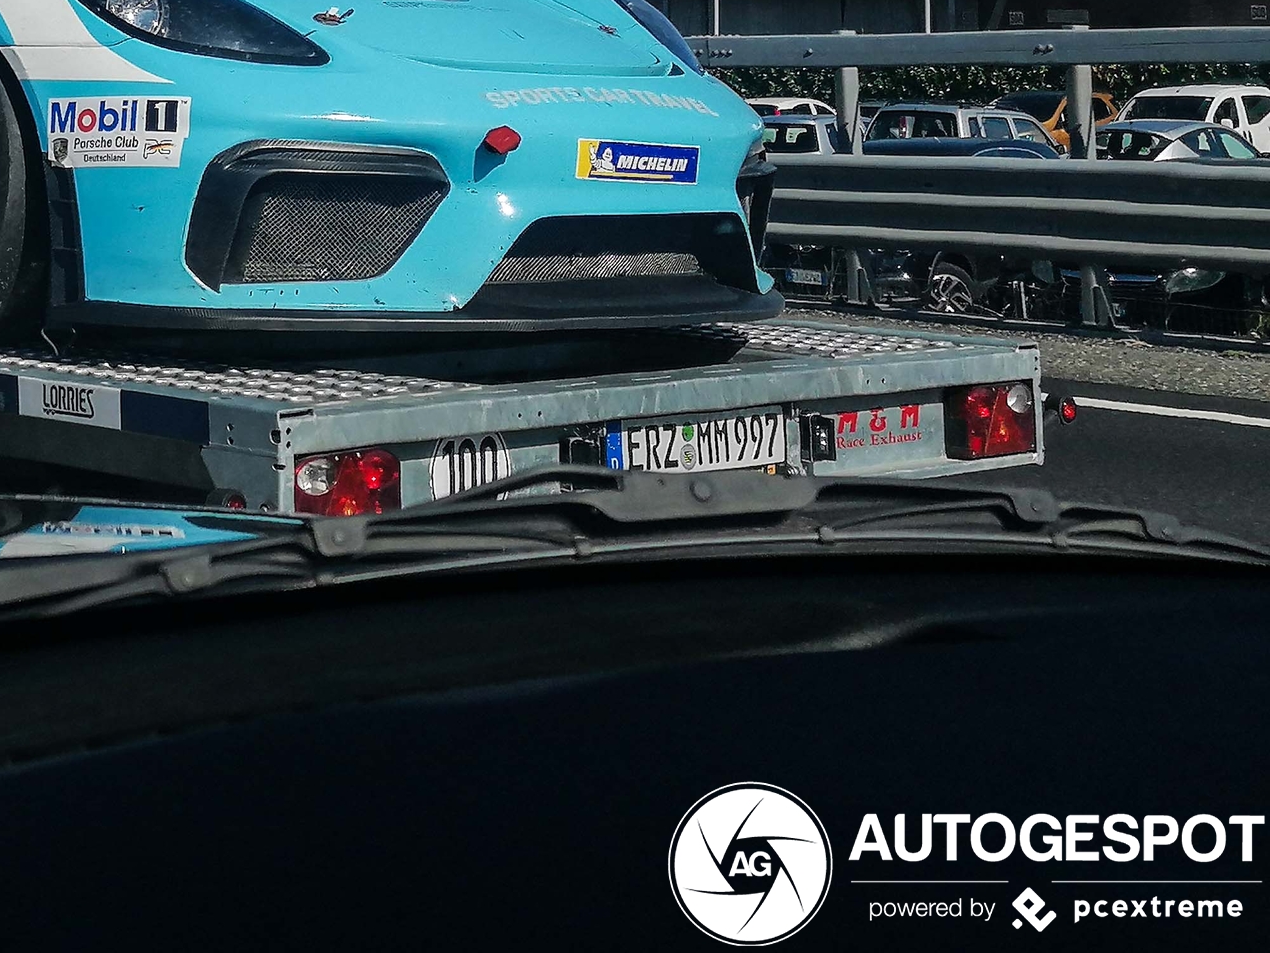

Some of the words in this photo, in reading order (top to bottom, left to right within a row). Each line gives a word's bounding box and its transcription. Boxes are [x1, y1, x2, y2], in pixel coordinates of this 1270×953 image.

[50, 100, 139, 133] Mobil
[73, 137, 113, 150] Porsche
[115, 135, 139, 149] Club
[83, 153, 126, 163] Deutschland
[616, 154, 689, 172] MICHELIN
[42, 383, 94, 419] LORRIES
[629, 424, 679, 472] ERZ
[696, 420, 731, 466] MM
[732, 413, 779, 461] 997
[836, 436, 865, 449] Race
[869, 431, 922, 446] Exhaust
[441, 435, 499, 495] 100
